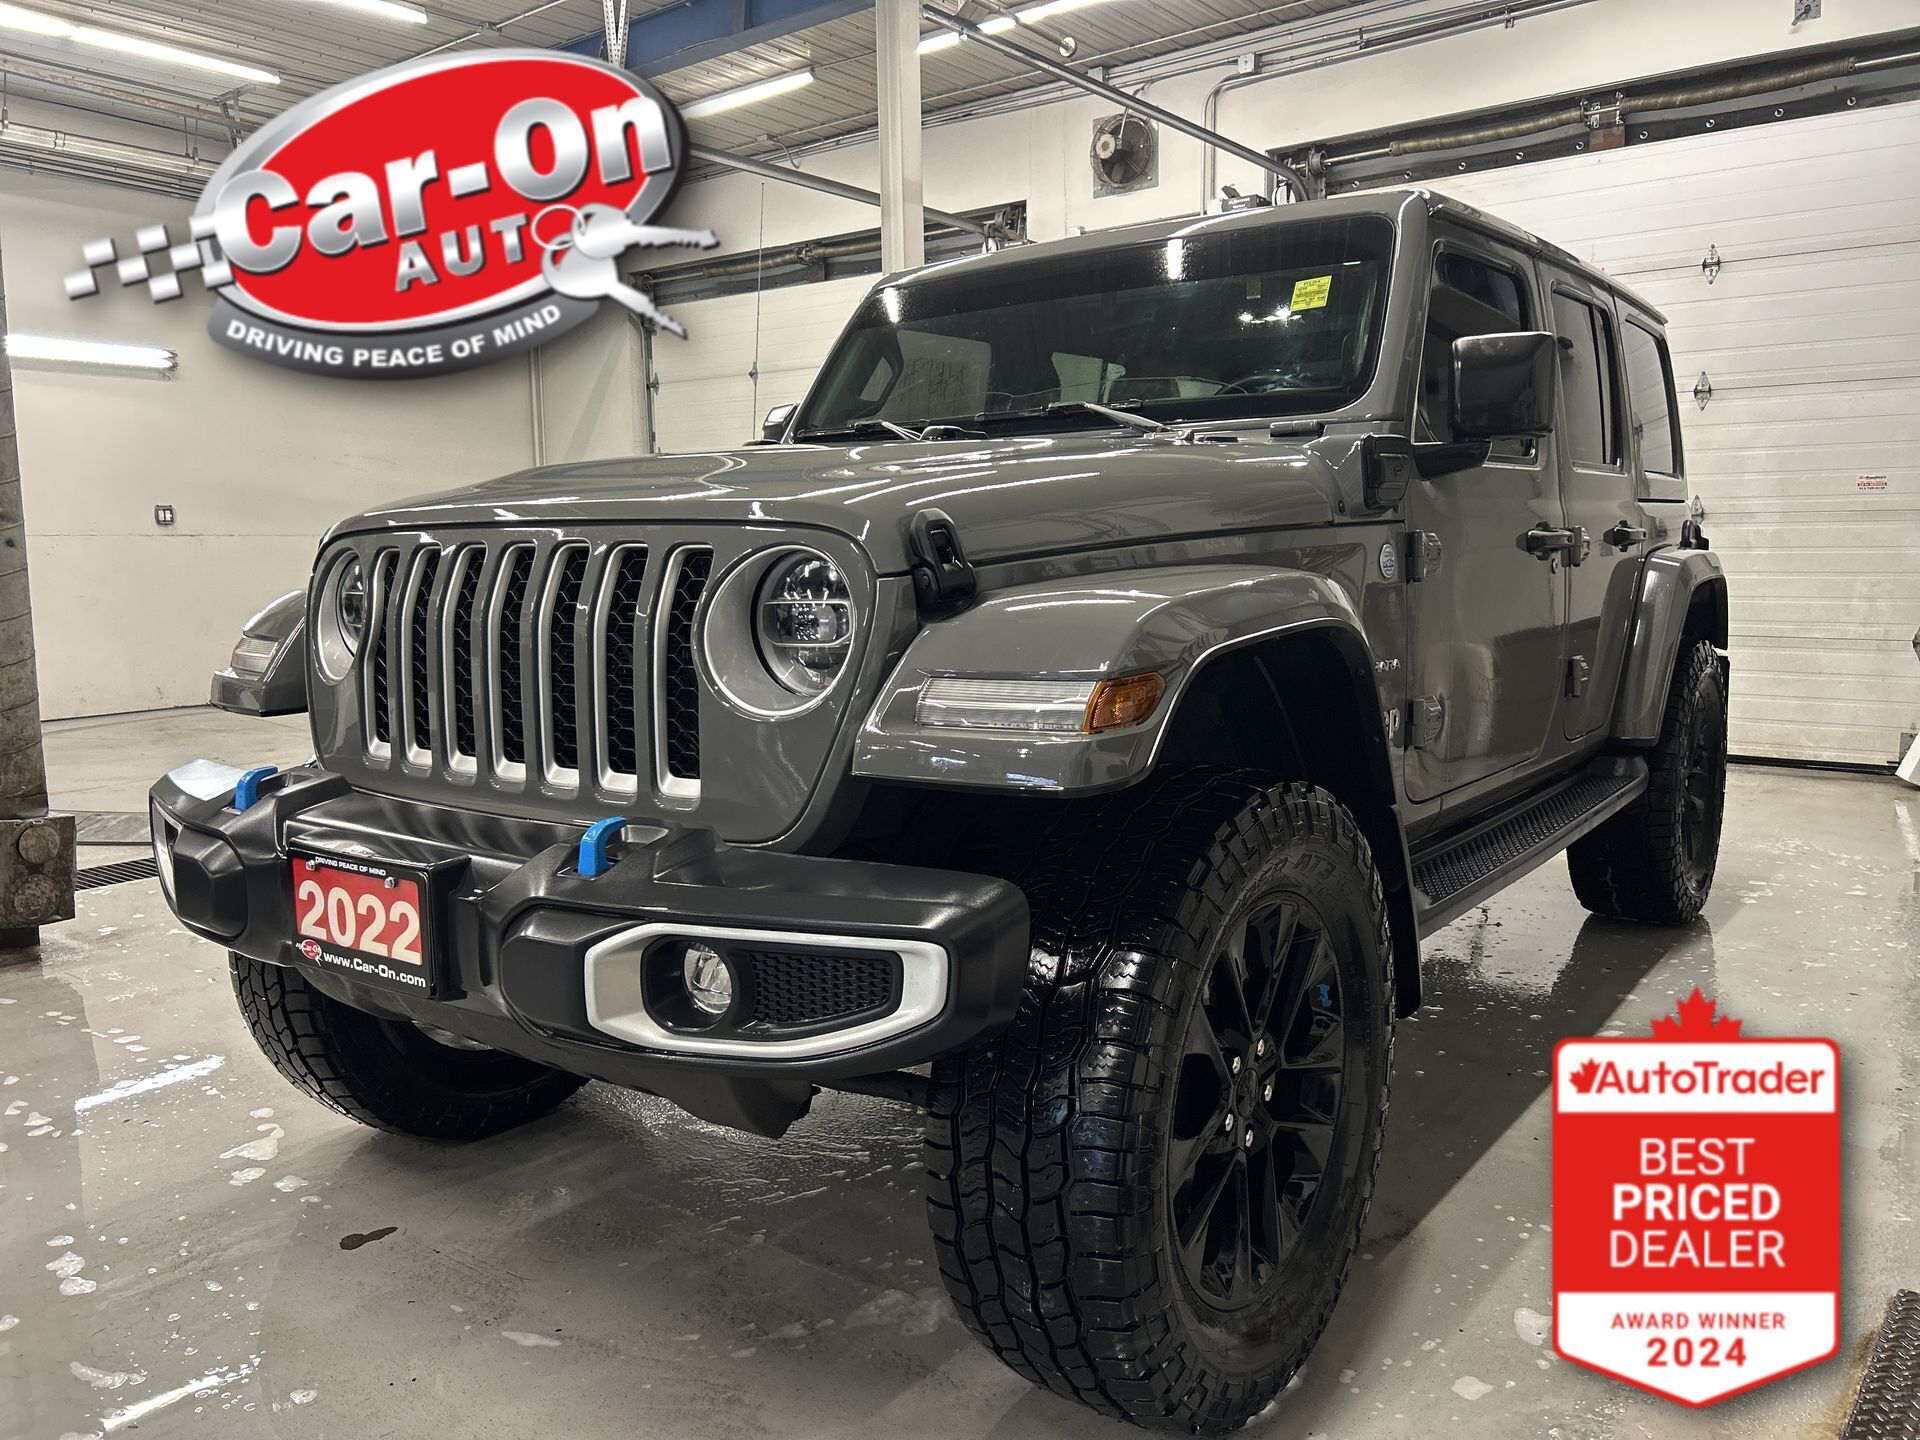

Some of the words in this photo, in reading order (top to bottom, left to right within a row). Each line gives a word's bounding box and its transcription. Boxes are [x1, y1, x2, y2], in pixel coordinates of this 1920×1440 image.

[315, 856, 338, 867] DRIVING
[338, 861, 359, 872] PEACE
[359, 865, 369, 873] OF
[369, 867, 387, 877] MIND
[298, 879, 423, 966] 2022
[323, 952, 427, 988] www.Car-On.com
